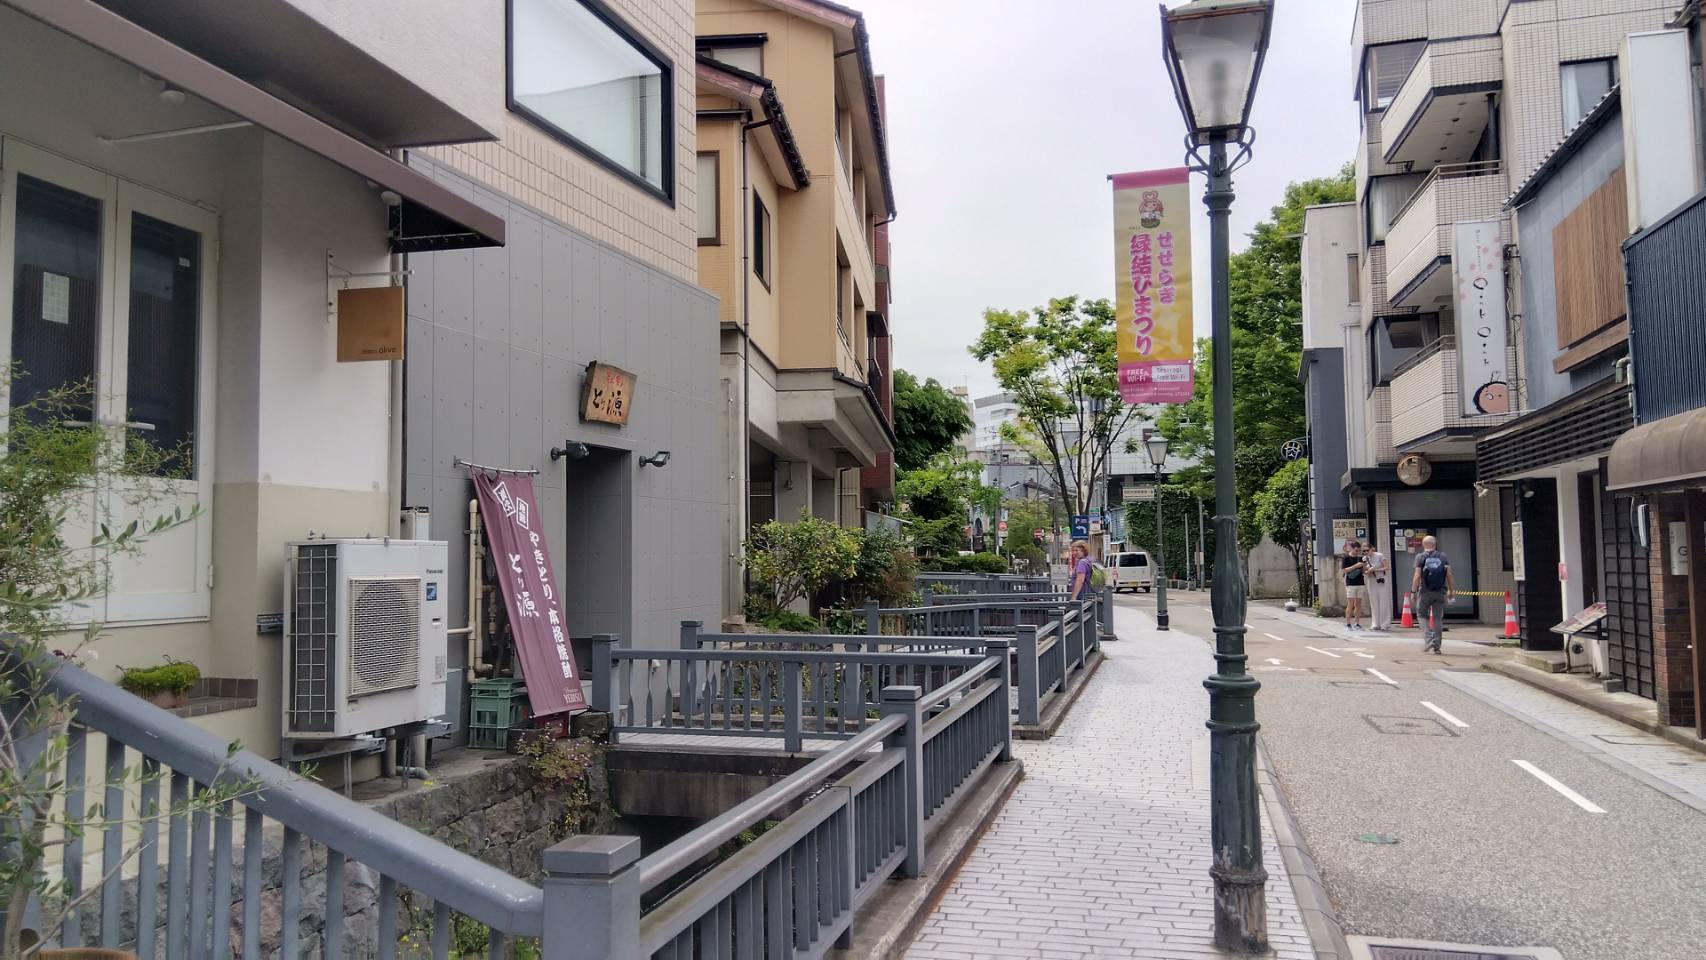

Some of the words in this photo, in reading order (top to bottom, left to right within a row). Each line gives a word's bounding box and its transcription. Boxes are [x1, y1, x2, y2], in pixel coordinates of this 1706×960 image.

[1130, 233, 1153, 356] 縁結びまつり
[1157, 231, 1176, 305] せせらぎ
[1357, 529, 1364, 537] P
